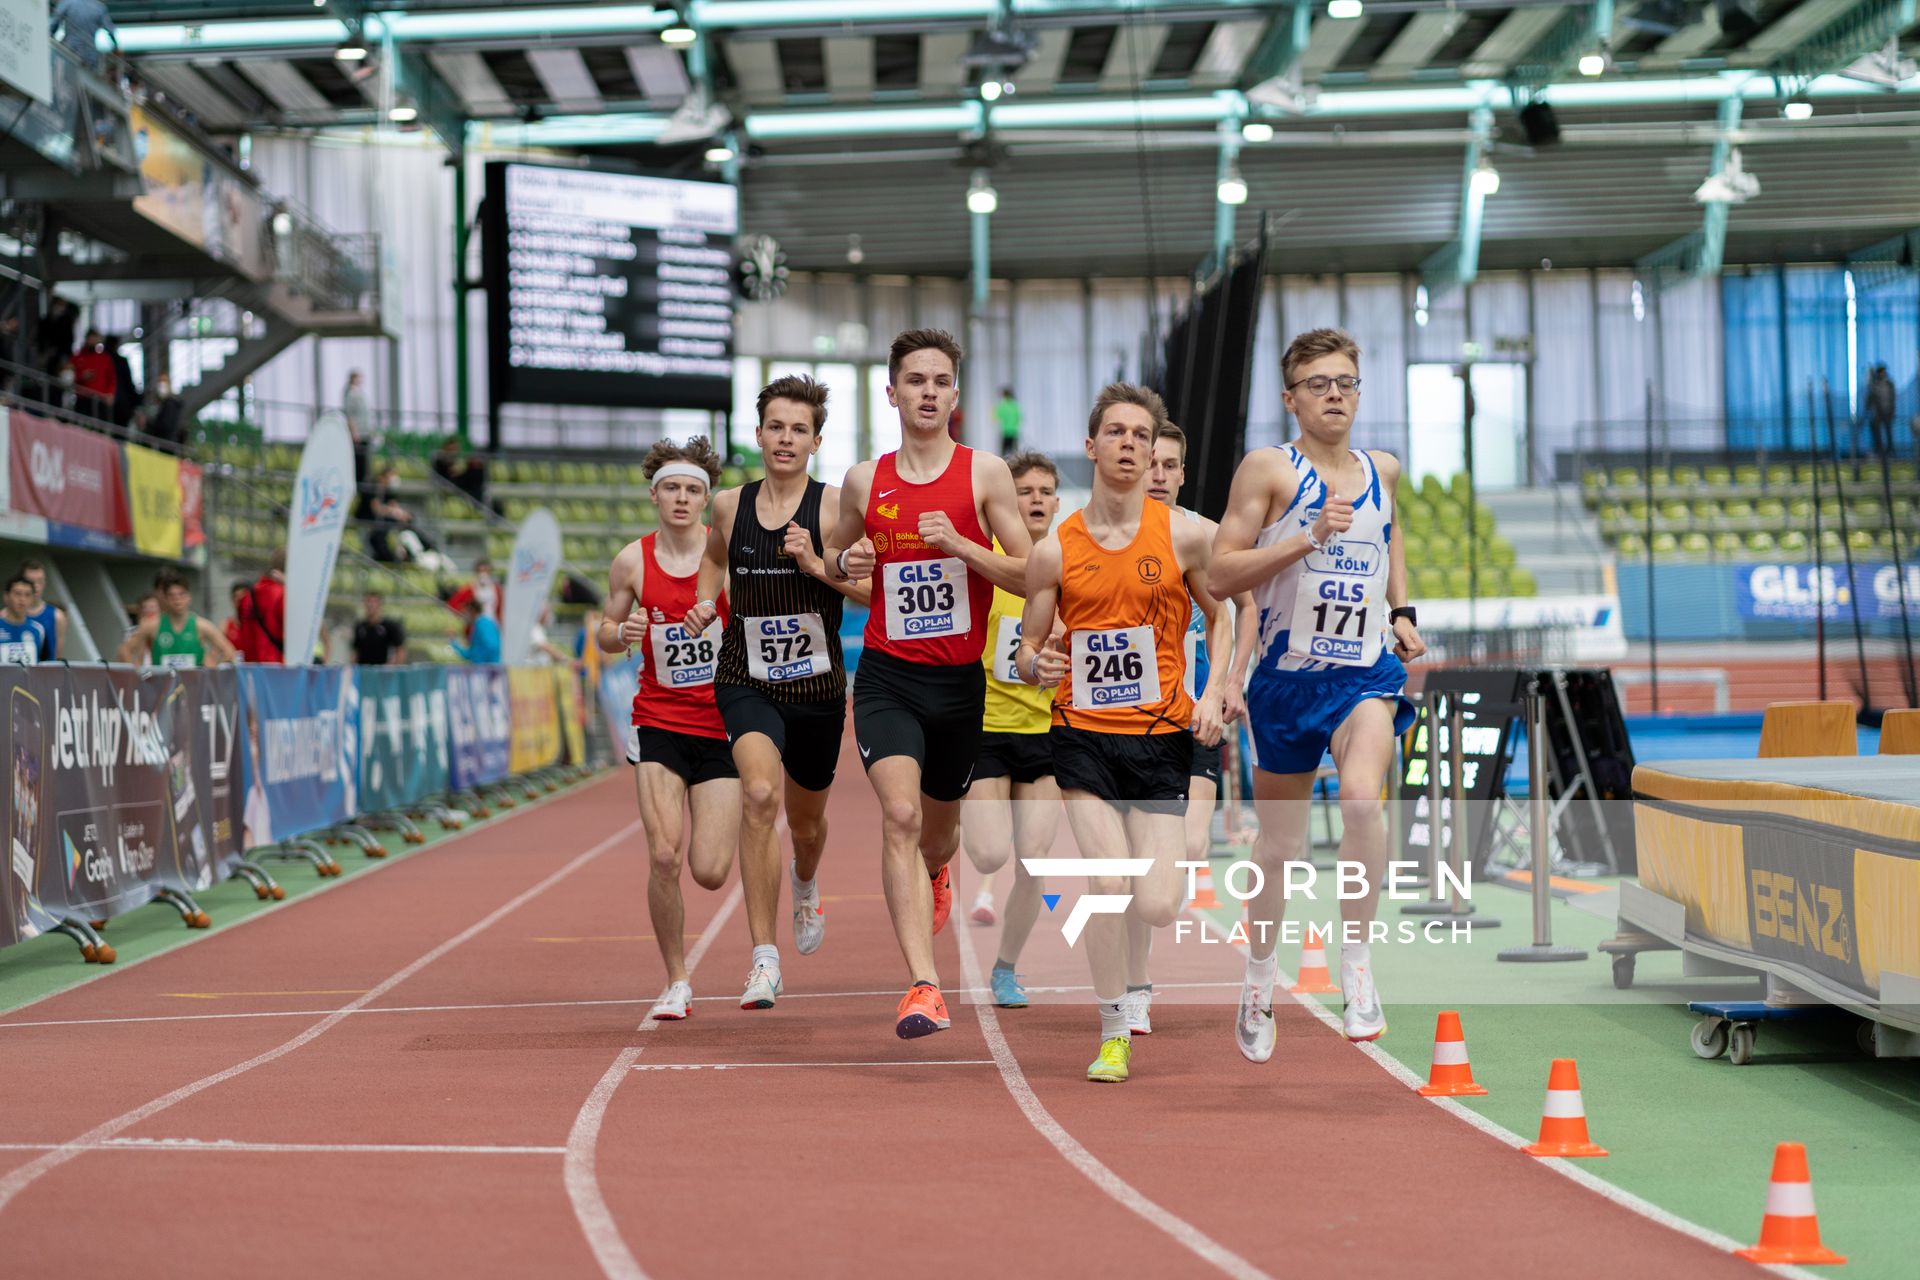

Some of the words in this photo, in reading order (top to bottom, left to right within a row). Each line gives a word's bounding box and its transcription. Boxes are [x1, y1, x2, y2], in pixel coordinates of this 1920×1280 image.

[766, 567, 795, 575] brückler
[1335, 557, 1369, 572] KÖLN
[898, 583, 955, 615] 303
[924, 616, 951, 627] PLAN
[1313, 602, 1367, 637] 171
[664, 640, 714, 667] 238
[760, 634, 813, 663] 572
[1333, 642, 1361, 654] PLAN
[688, 667, 711, 678] PLAN
[785, 662, 811, 675] PLAN
[1085, 652, 1143, 683] 246
[1111, 687, 1138, 697] PLAN
[1751, 868, 1845, 962] BENZ
